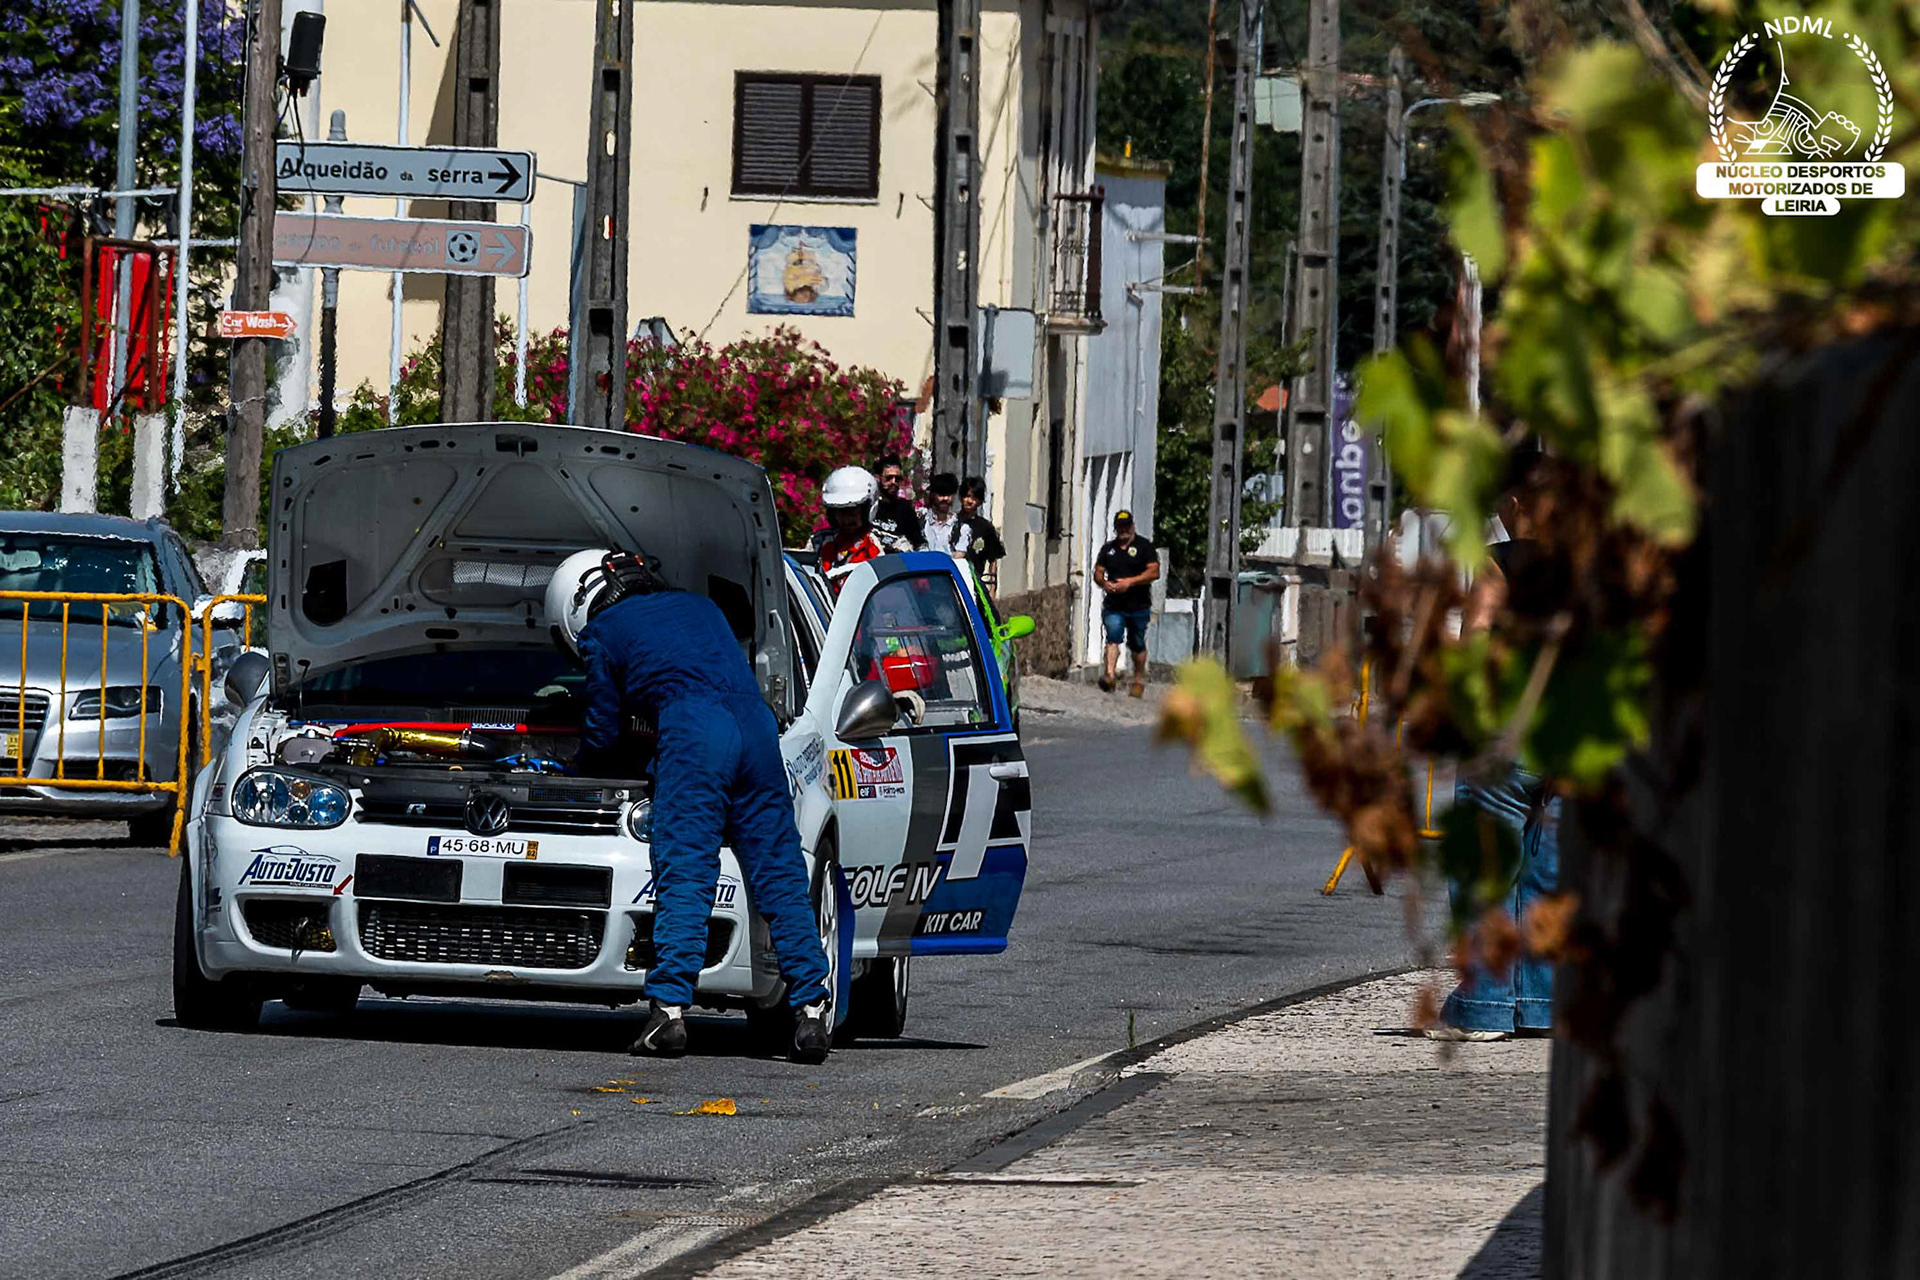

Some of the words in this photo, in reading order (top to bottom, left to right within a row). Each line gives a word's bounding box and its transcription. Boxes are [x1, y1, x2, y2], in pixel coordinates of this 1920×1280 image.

[278, 156, 388, 181] Alqueidão
[400, 170, 414, 182] da
[427, 167, 484, 185] serra
[222, 315, 243, 328] Car
[246, 314, 277, 329] Wash
[833, 750, 854, 799] 11
[406, 803, 427, 814] R
[429, 845, 437, 854] P
[923, 912, 949, 934] KIT
[950, 910, 982, 931] CAR
